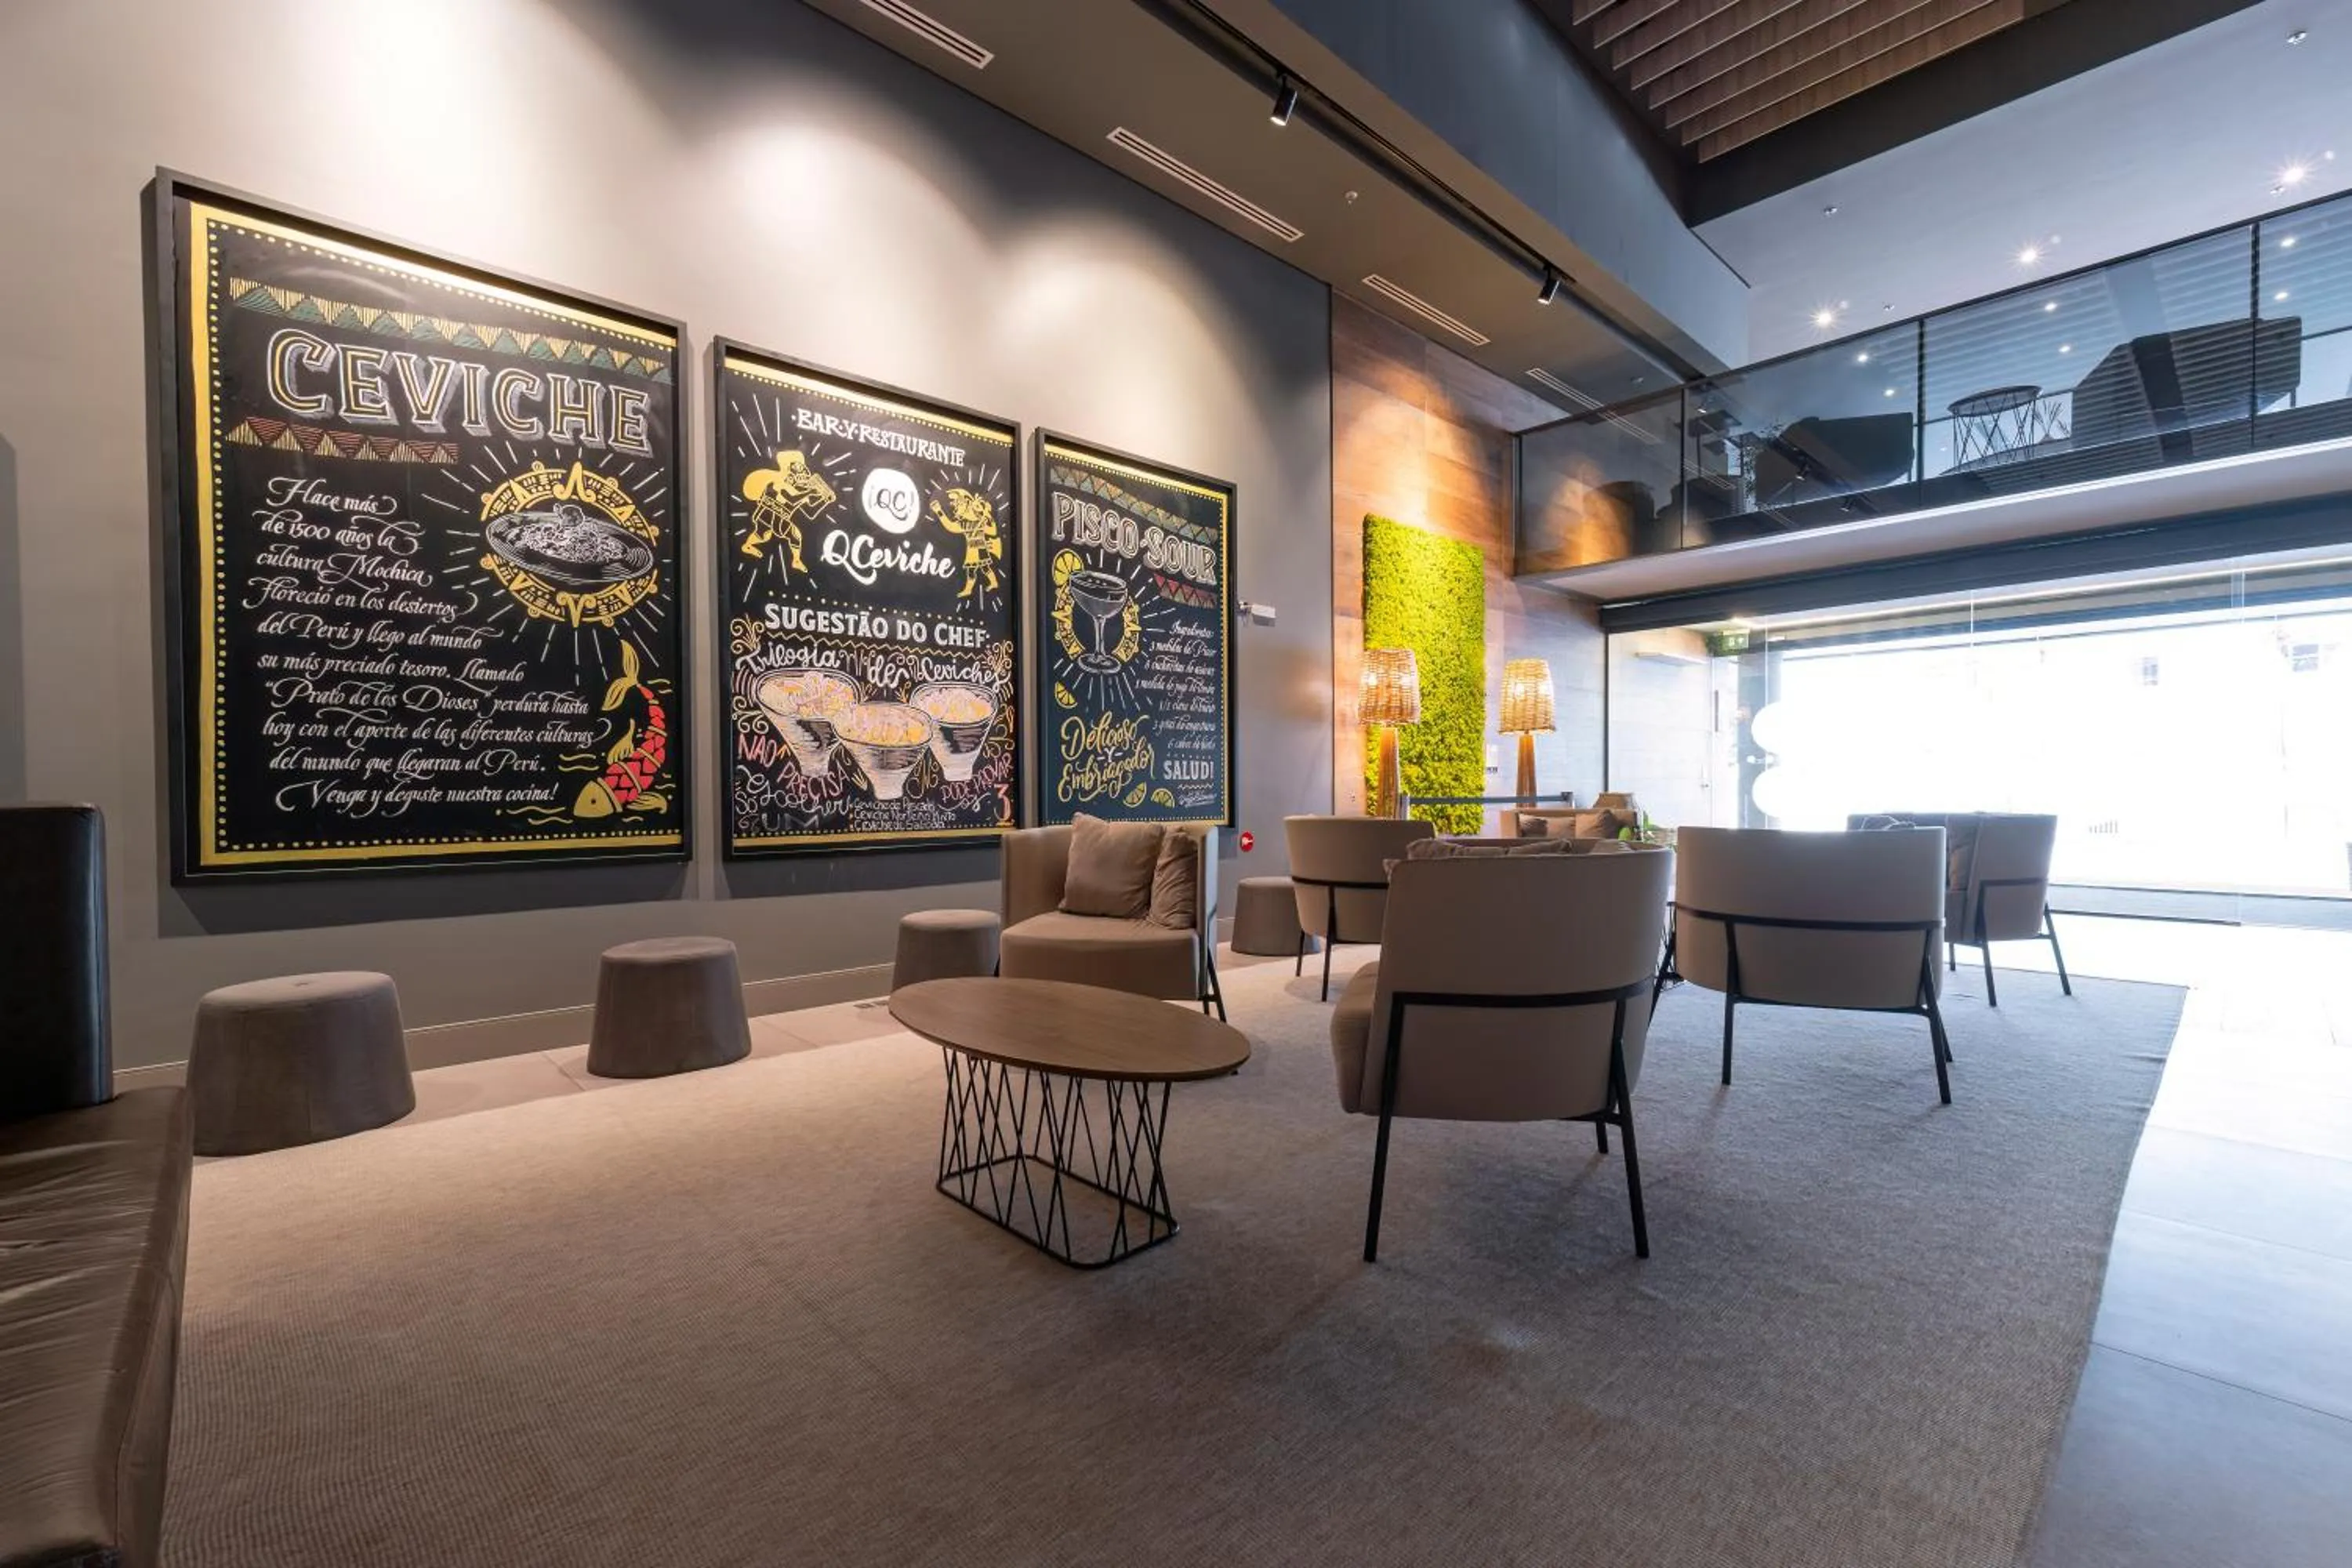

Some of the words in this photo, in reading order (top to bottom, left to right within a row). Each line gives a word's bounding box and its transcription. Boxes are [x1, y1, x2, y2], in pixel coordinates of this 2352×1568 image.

[267, 328, 654, 458] CEVICHE
[266, 477, 343, 512] Hace
[344, 495, 397, 515] más
[252, 509, 303, 533] de
[289, 521, 331, 540] 1500
[336, 526, 373, 550] años
[377, 516, 425, 556] la
[1051, 491, 1139, 560] PISCO
[1143, 526, 1218, 586] SOUR
[257, 544, 324, 578] cultura
[325, 553, 433, 587] Mochica
[243, 576, 334, 609] Floreció
[336, 594, 357, 608] en
[360, 584, 387, 610] los
[389, 590, 477, 623] desiertos
[257, 612, 298, 634] del
[289, 614, 351, 638] Perú
[367, 620, 405, 652] llego
[408, 625, 435, 646] al
[430, 626, 500, 650] mundo
[764, 603, 888, 639] SUGESTÃO
[896, 620, 927, 642] DO
[257, 654, 278, 669] su
[283, 652, 321, 670] más
[310, 653, 399, 680] preciado
[399, 659, 451, 678] tesoro.
[453, 658, 528, 695] Llamado
[735, 641, 840, 674] Trilogia
[349, 681, 375, 706] de
[373, 684, 398, 706] los
[477, 692, 549, 719] perdura
[546, 691, 589, 714] hasta
[262, 711, 296, 746] hoy
[299, 723, 328, 738] con
[347, 721, 408, 748] aporte
[412, 717, 436, 739] de
[434, 718, 457, 747] las
[459, 719, 534, 750] diferentes
[536, 717, 612, 749] culturas
[269, 746, 312, 770] del
[302, 747, 365, 771] mundo
[363, 756, 394, 780] que
[465, 750, 491, 771] al
[274, 779, 366, 814] Venga
[350, 789, 382, 819] y
[381, 779, 443, 818] deguste
[446, 786, 503, 803] nuestra
[505, 782, 560, 801] cocina!
